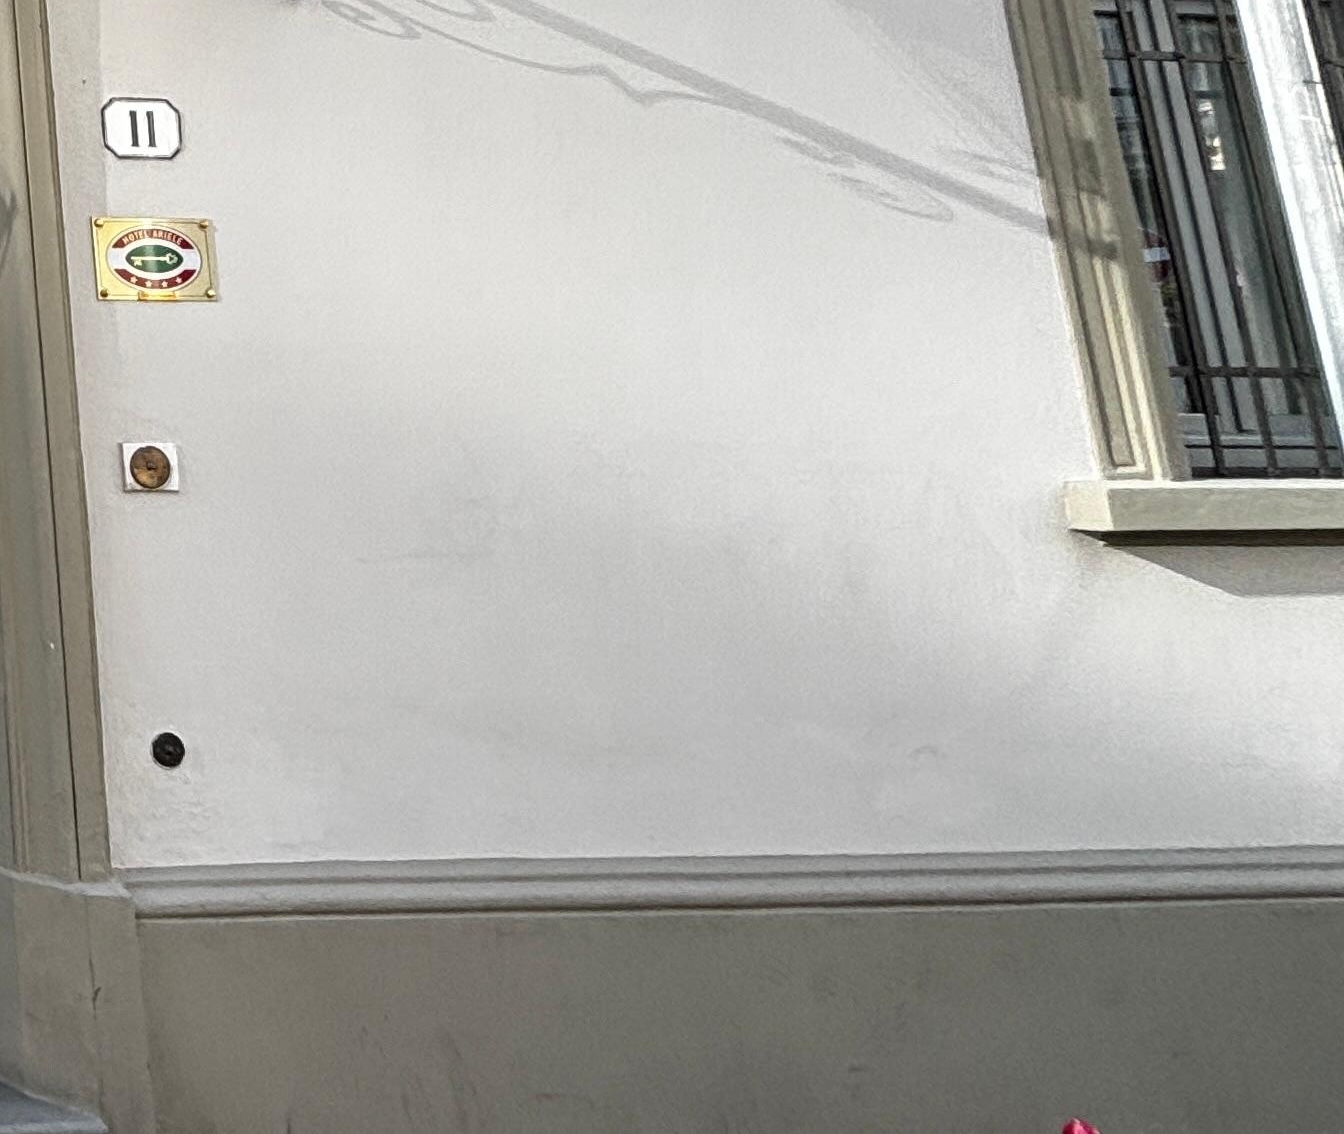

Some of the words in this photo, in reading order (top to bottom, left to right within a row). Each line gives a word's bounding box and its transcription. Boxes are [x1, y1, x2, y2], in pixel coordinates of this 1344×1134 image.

[129, 110, 157, 147] 11
[122, 230, 149, 245] HOTEL
[153, 230, 183, 246] ARIELE
